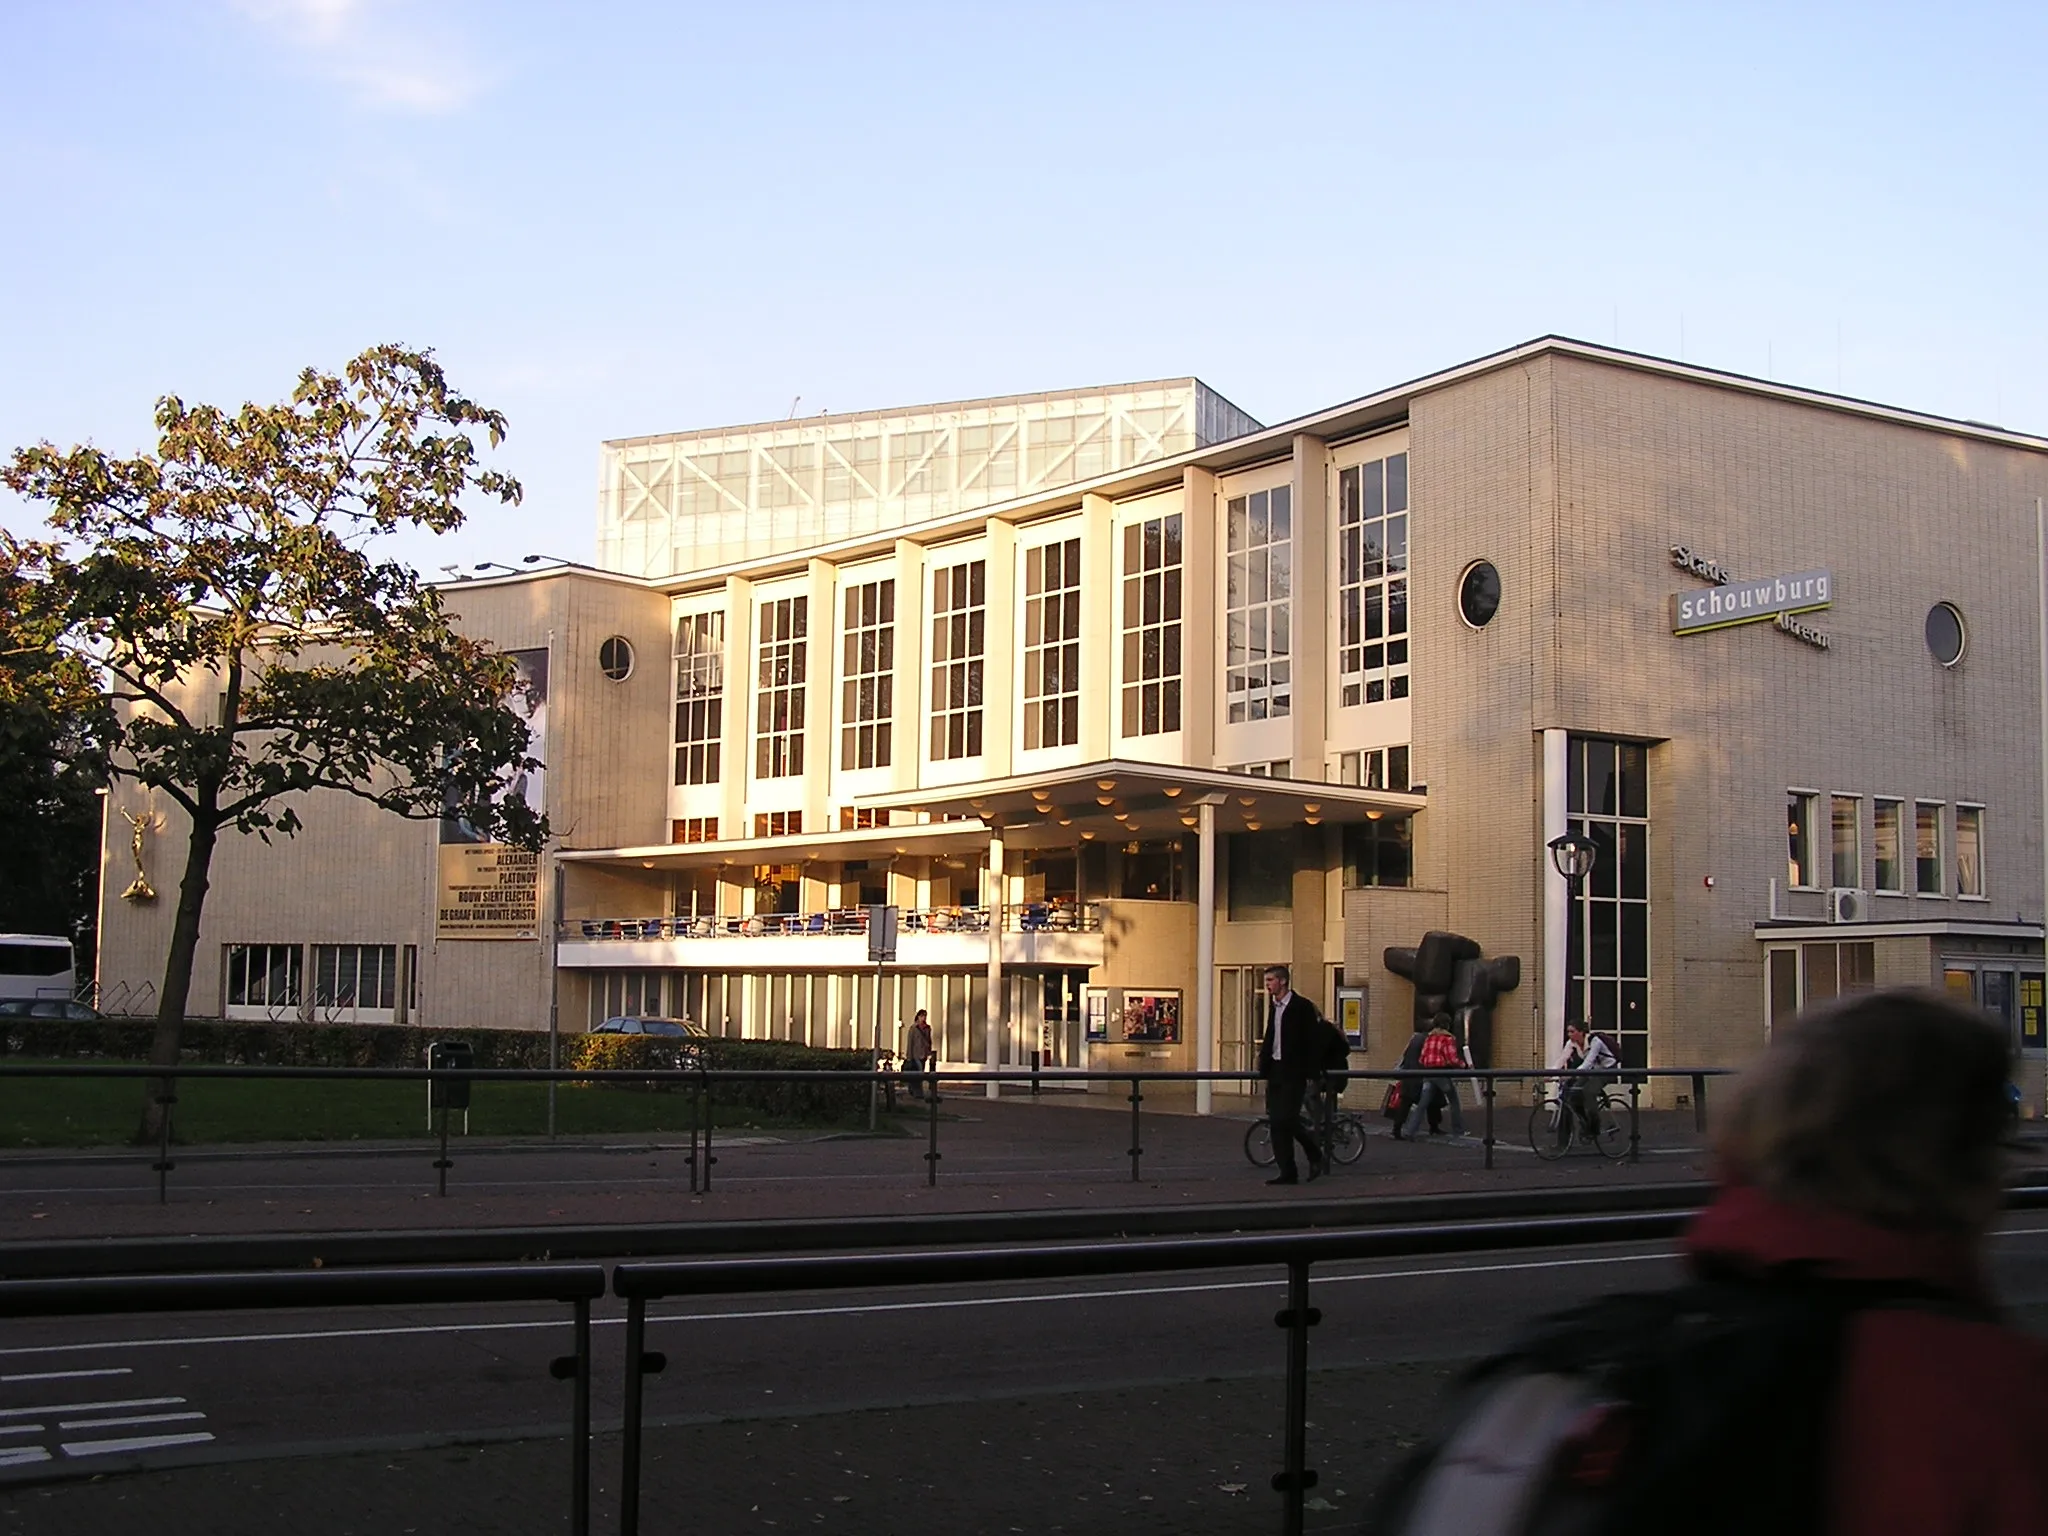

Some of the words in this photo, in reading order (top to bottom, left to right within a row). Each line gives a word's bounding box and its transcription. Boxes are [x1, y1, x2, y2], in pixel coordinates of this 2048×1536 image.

[1672, 544, 1729, 585] Stads
[1681, 575, 1828, 620] schouwburg
[497, 854, 538, 866] ALEXANDER
[499, 872, 538, 884] PLATONOV
[458, 891, 482, 903] ROUW
[504, 890, 536, 902] ELECTRA
[440, 909, 449, 921] DE
[449, 909, 471, 921] GRAAF
[472, 909, 486, 921] VAN
[486, 909, 510, 921] MONTE
[510, 909, 536, 921] CRISTO
